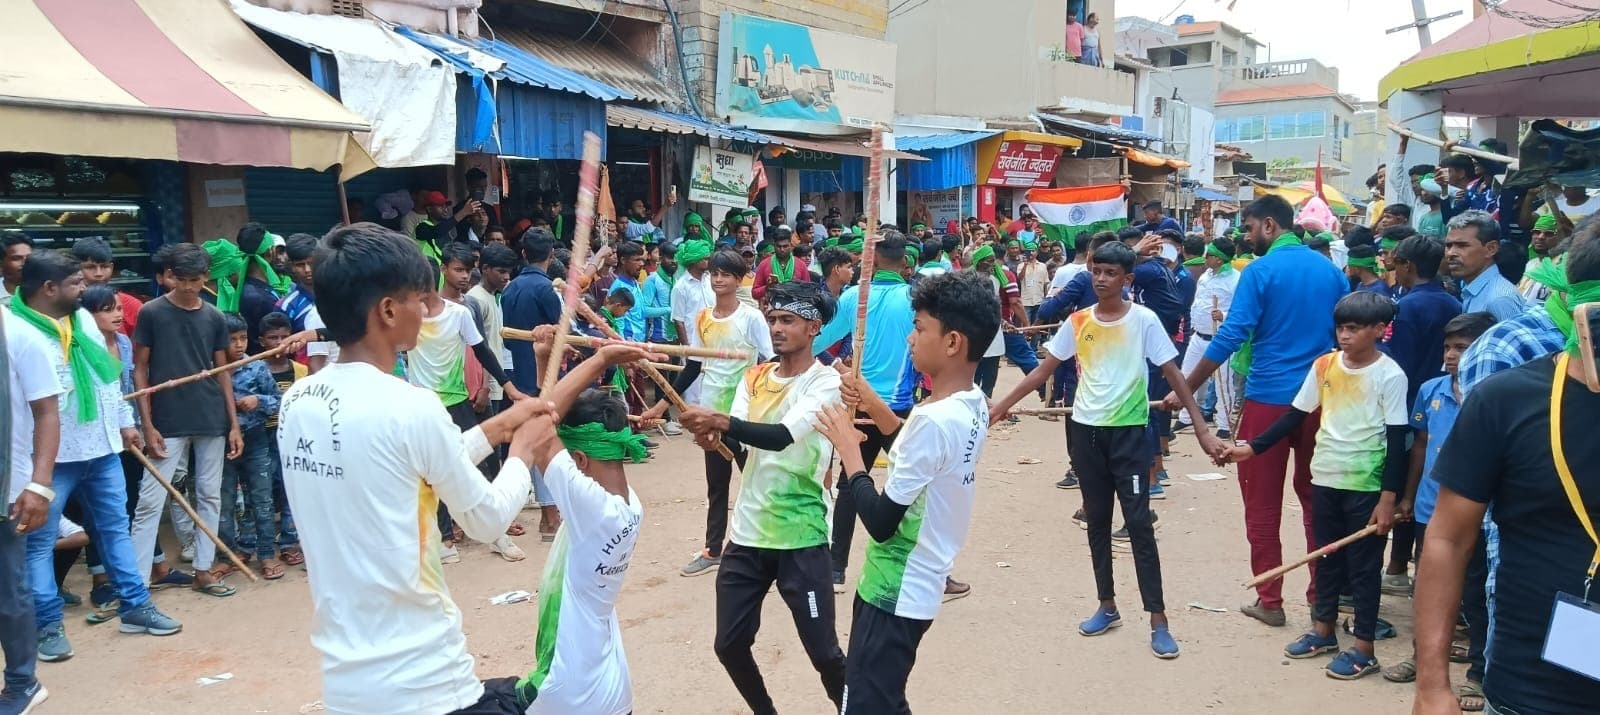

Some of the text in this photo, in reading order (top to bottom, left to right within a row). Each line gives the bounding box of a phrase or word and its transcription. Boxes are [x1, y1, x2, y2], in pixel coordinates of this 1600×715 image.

[715, 153, 736, 170] सुधा
[998, 150, 1028, 171] सर्वजीत
[296, 437, 314, 455] AK
